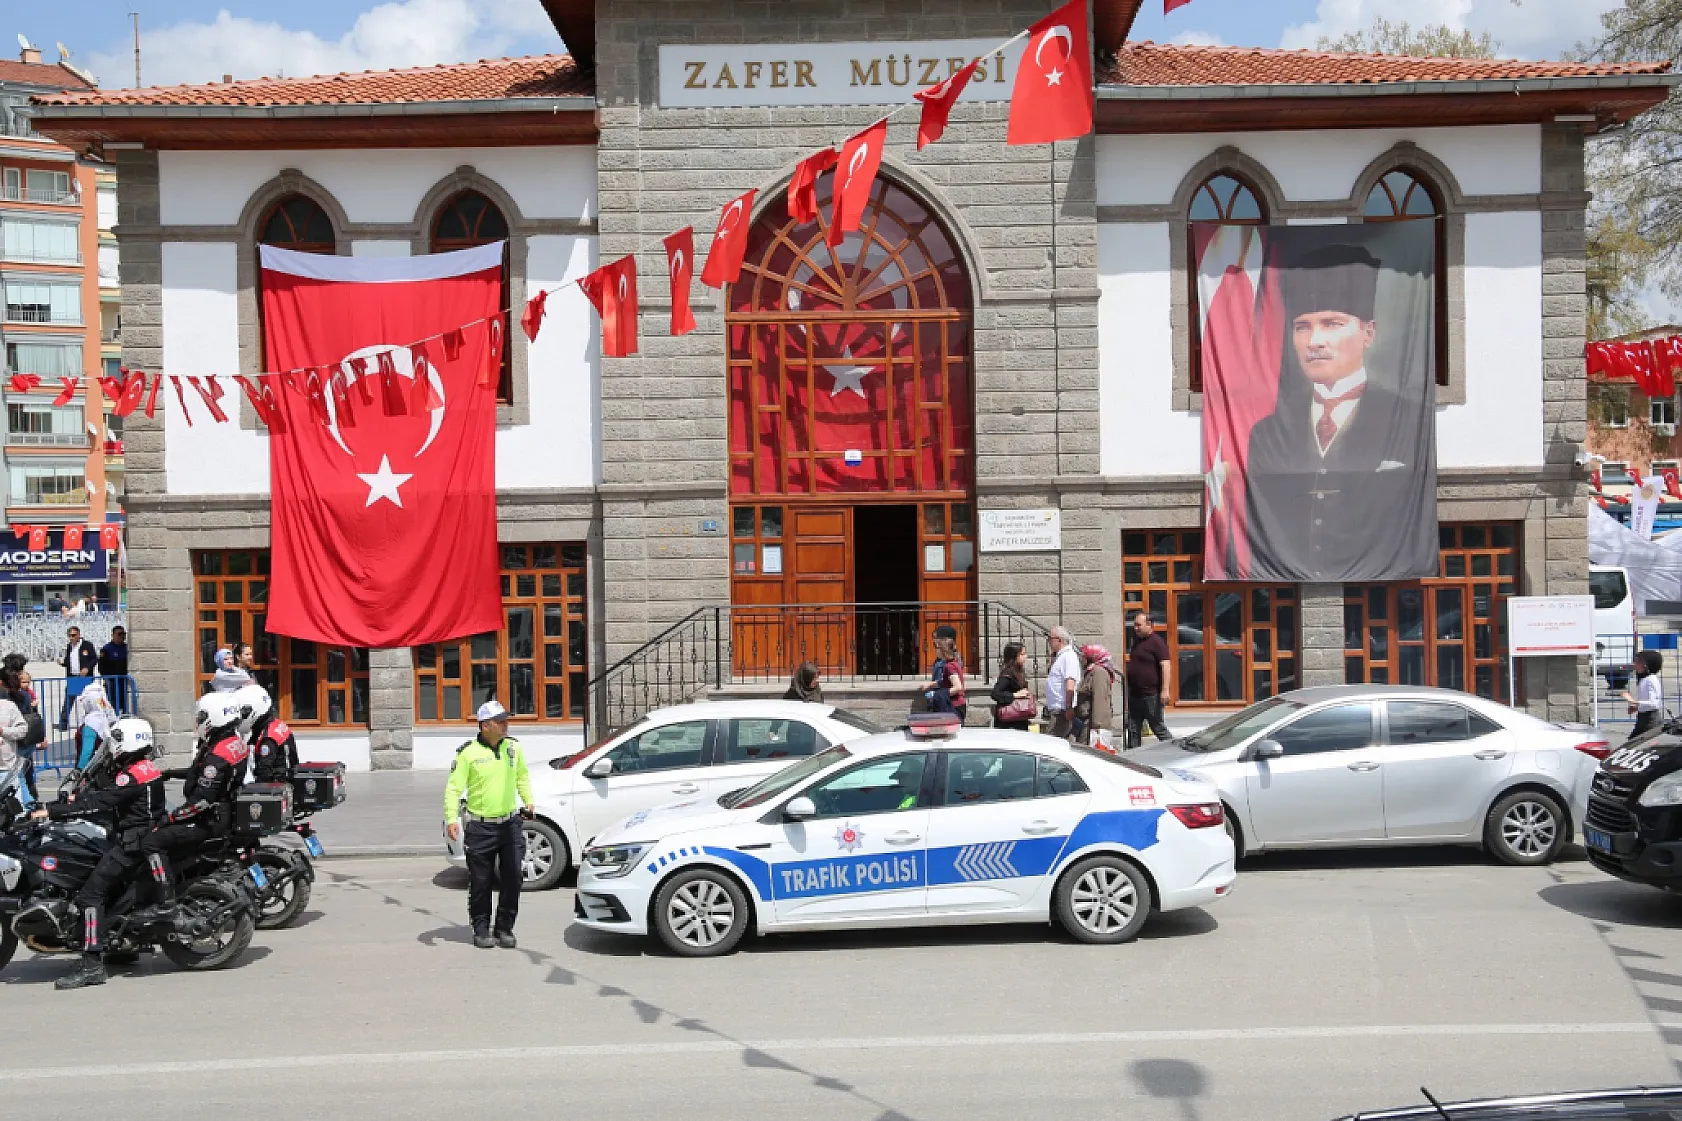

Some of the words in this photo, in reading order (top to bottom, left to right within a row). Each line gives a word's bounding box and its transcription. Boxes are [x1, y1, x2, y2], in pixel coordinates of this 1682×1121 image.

[683, 60, 817, 89] ZAFER
[781, 863, 850, 892] TRAFİK
[856, 856, 917, 886] POLİSİ
